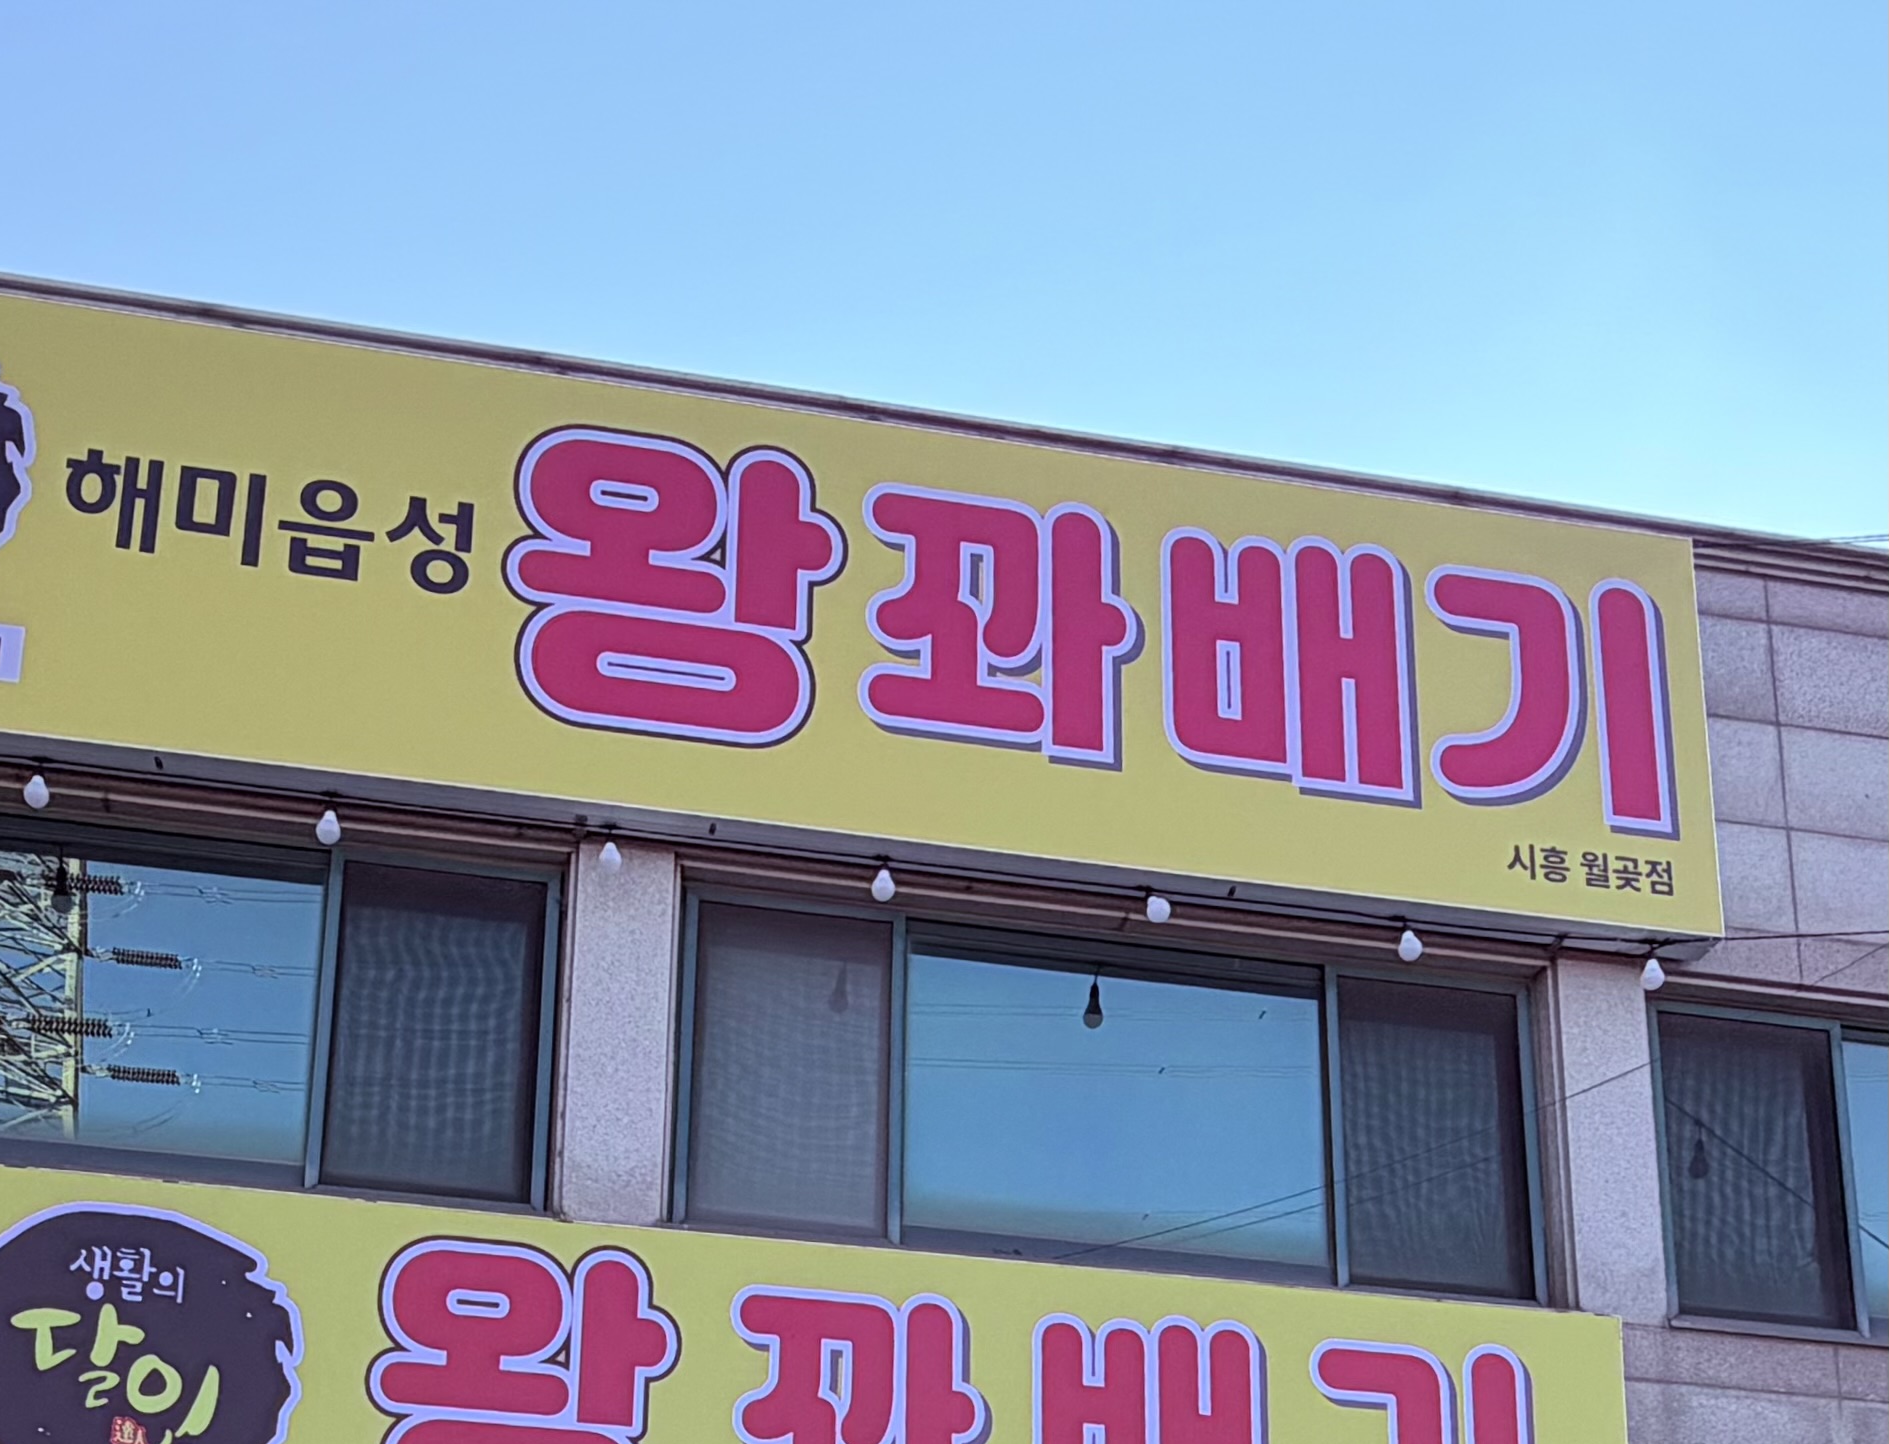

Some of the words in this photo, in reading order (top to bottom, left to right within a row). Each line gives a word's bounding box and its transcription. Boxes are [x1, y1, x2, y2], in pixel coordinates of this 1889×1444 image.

[64, 447, 476, 594] 해미읍성
[501, 423, 1680, 840] 왕꽈배기
[1507, 843, 1571, 883] 시흥
[1580, 851, 1674, 897] 월곶점
[70, 1244, 185, 1304] 생활의
